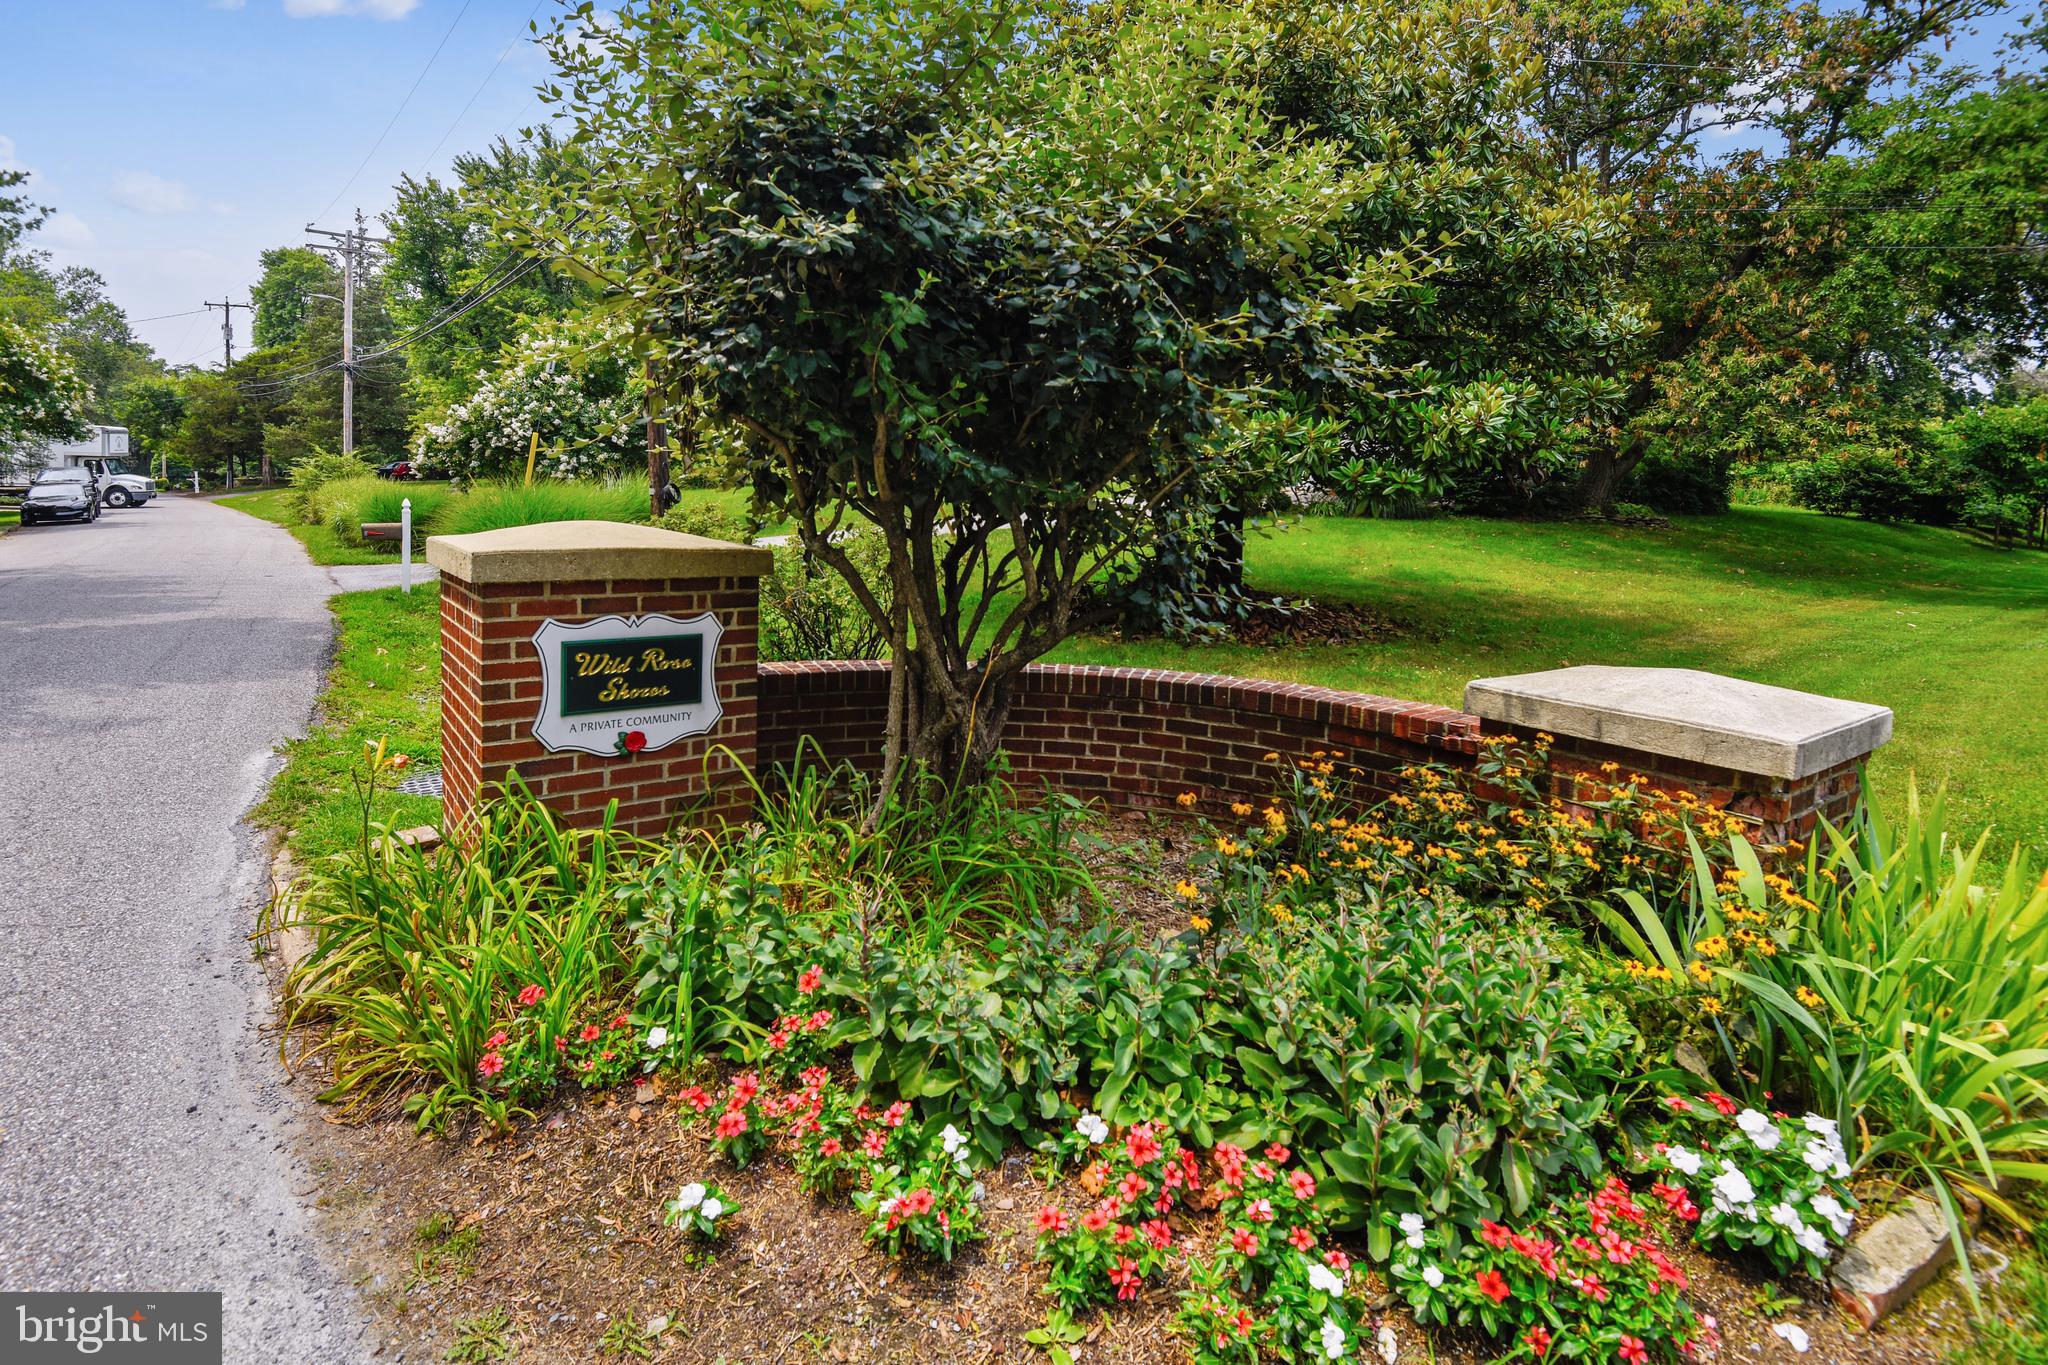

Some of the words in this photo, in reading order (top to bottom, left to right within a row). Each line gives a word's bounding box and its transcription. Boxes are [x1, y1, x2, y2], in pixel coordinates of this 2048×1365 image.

[575, 652, 634, 677] Wild
[637, 647, 693, 673] Rose
[598, 677, 671, 702] Shores
[569, 723, 577, 734] A
[580, 719, 623, 732] PRIVATE
[626, 711, 692, 727] COMMUNITY
